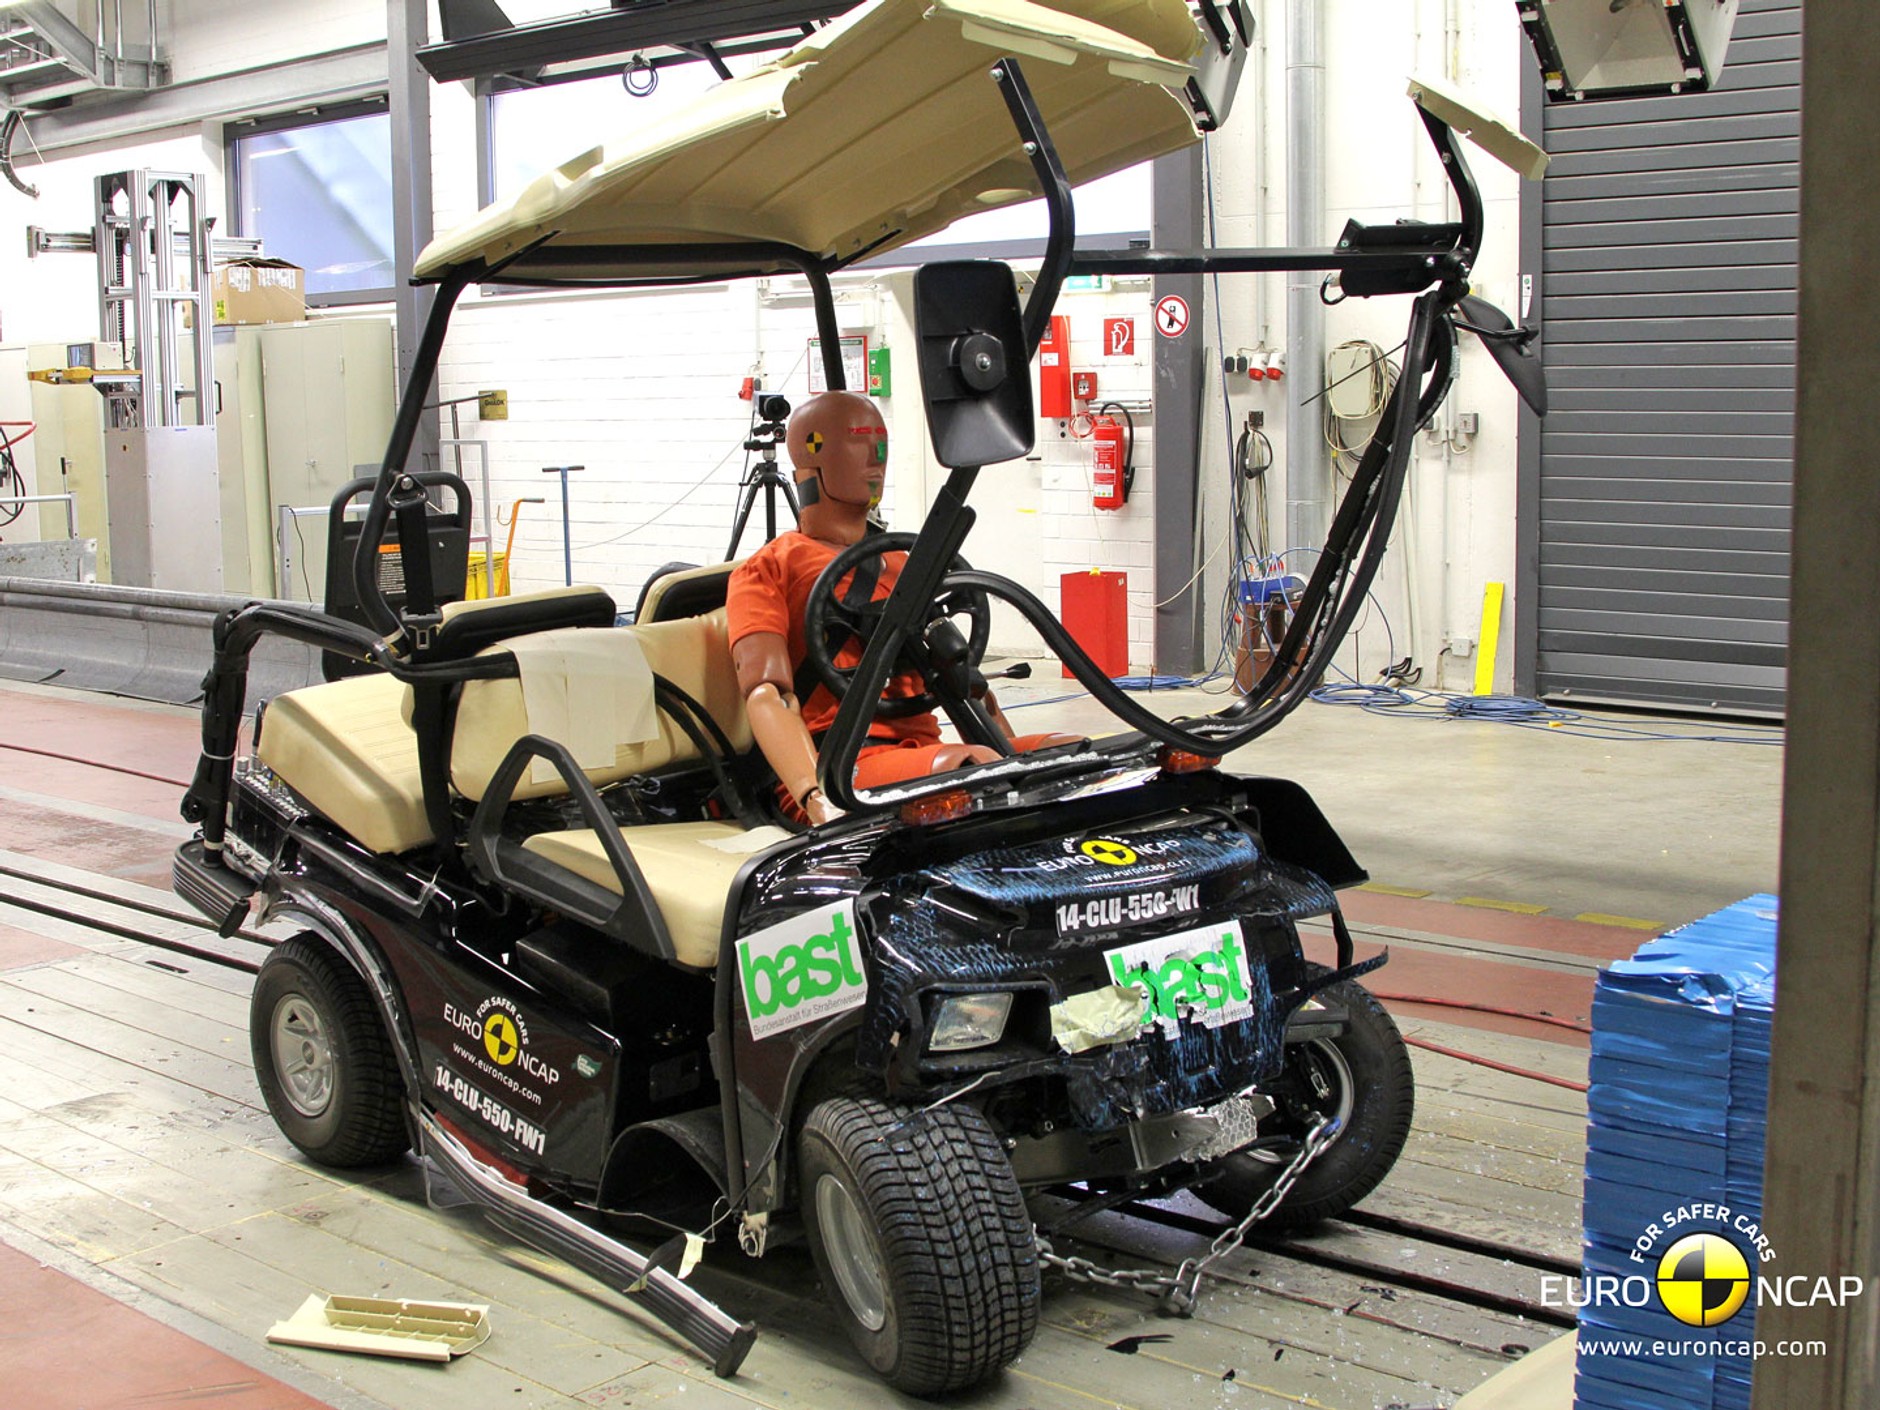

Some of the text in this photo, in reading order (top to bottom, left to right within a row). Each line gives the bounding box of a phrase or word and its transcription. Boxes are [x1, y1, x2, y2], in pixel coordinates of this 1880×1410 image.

[740, 912, 863, 1020] bast
[1109, 932, 1249, 1025] bast
[443, 1003, 482, 1041] EURO
[517, 1050, 560, 1085] NCAP
[476, 996, 529, 1045] FOR SAFER CARS
[435, 1065, 546, 1156] 14-CLU-550-FW1
[453, 1043, 542, 1106] www.euroncap.com
